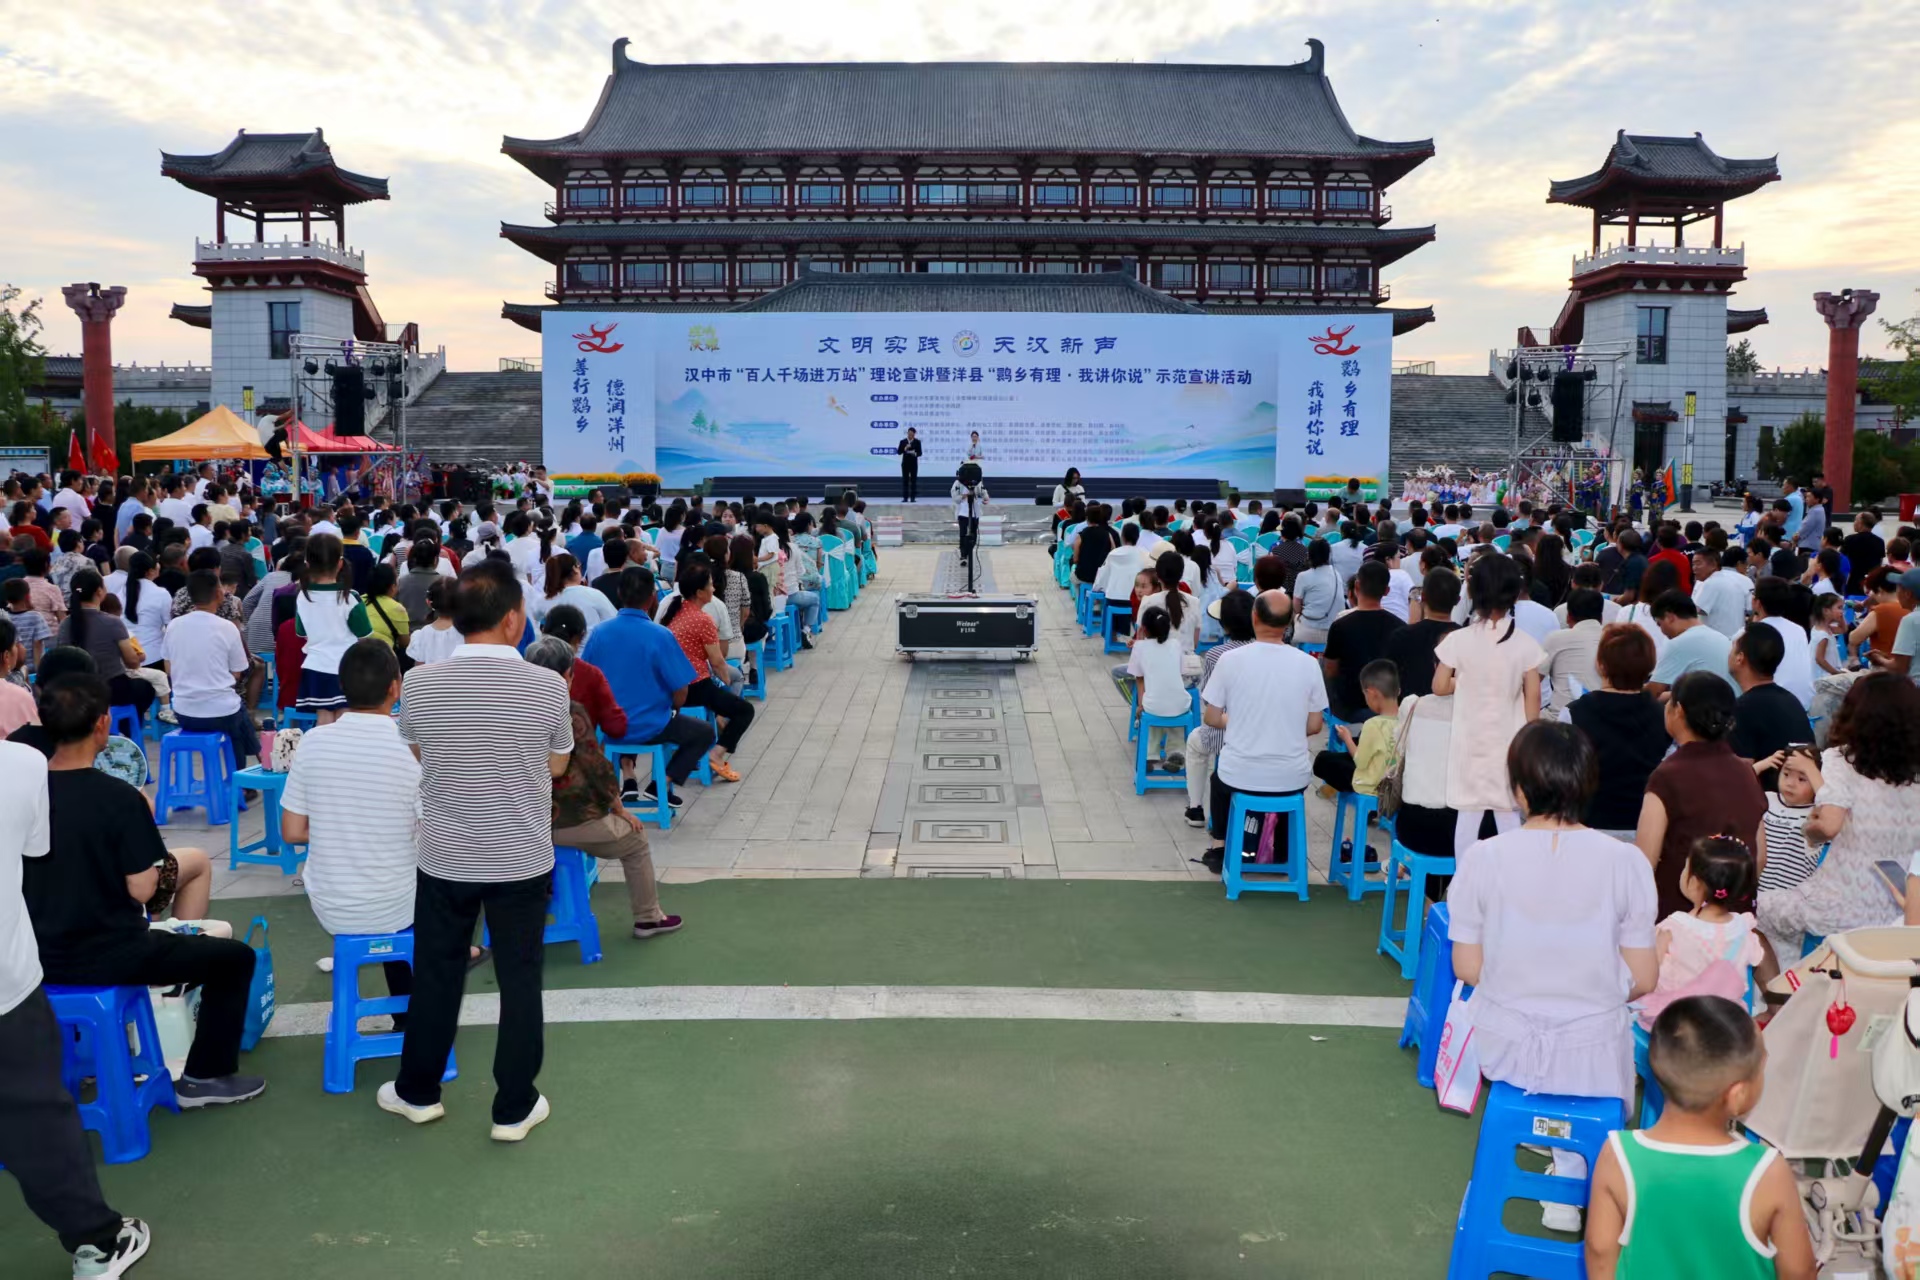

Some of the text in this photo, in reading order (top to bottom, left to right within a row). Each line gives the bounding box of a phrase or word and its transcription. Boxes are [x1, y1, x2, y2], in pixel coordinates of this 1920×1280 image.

[818, 336, 941, 354] 文明实践
[993, 336, 1118, 354] 天汉新声
[572, 358, 592, 433] 善行鹮乡
[606, 379, 626, 453] 德润洋州
[1306, 380, 1325, 456] 我讲你说
[1340, 360, 1361, 437] 鹮乡有理
